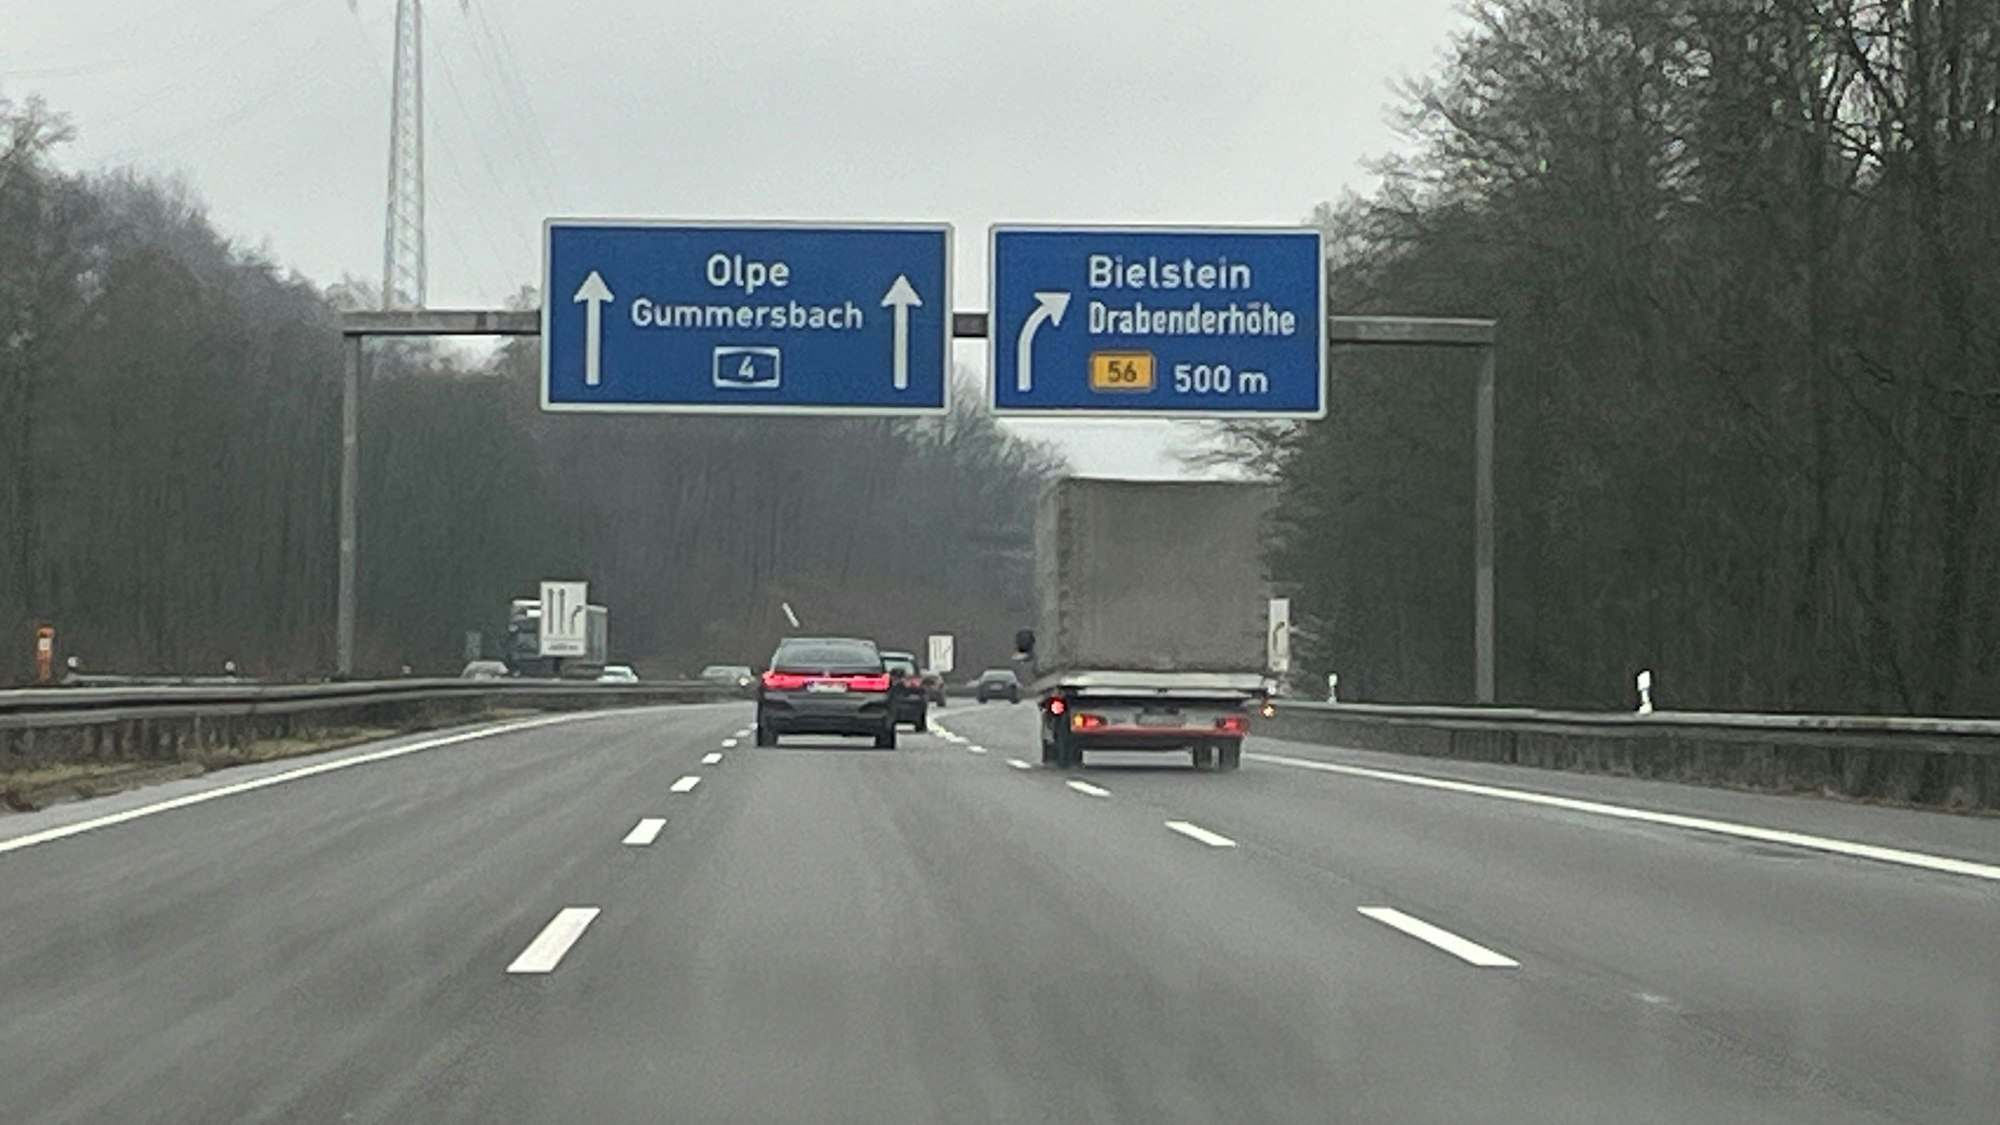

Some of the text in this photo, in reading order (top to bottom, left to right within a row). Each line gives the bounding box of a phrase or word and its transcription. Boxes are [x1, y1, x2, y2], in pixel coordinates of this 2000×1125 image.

[707, 253, 790, 295] Olpe
[1089, 255, 1251, 289] Bielstein
[631, 298, 863, 329] Gummersbach
[1089, 301, 1296, 335] Drabenderhöhe
[738, 355, 755, 379] 4
[1108, 360, 1138, 383] 56
[1174, 365, 1269, 393] 500 m
